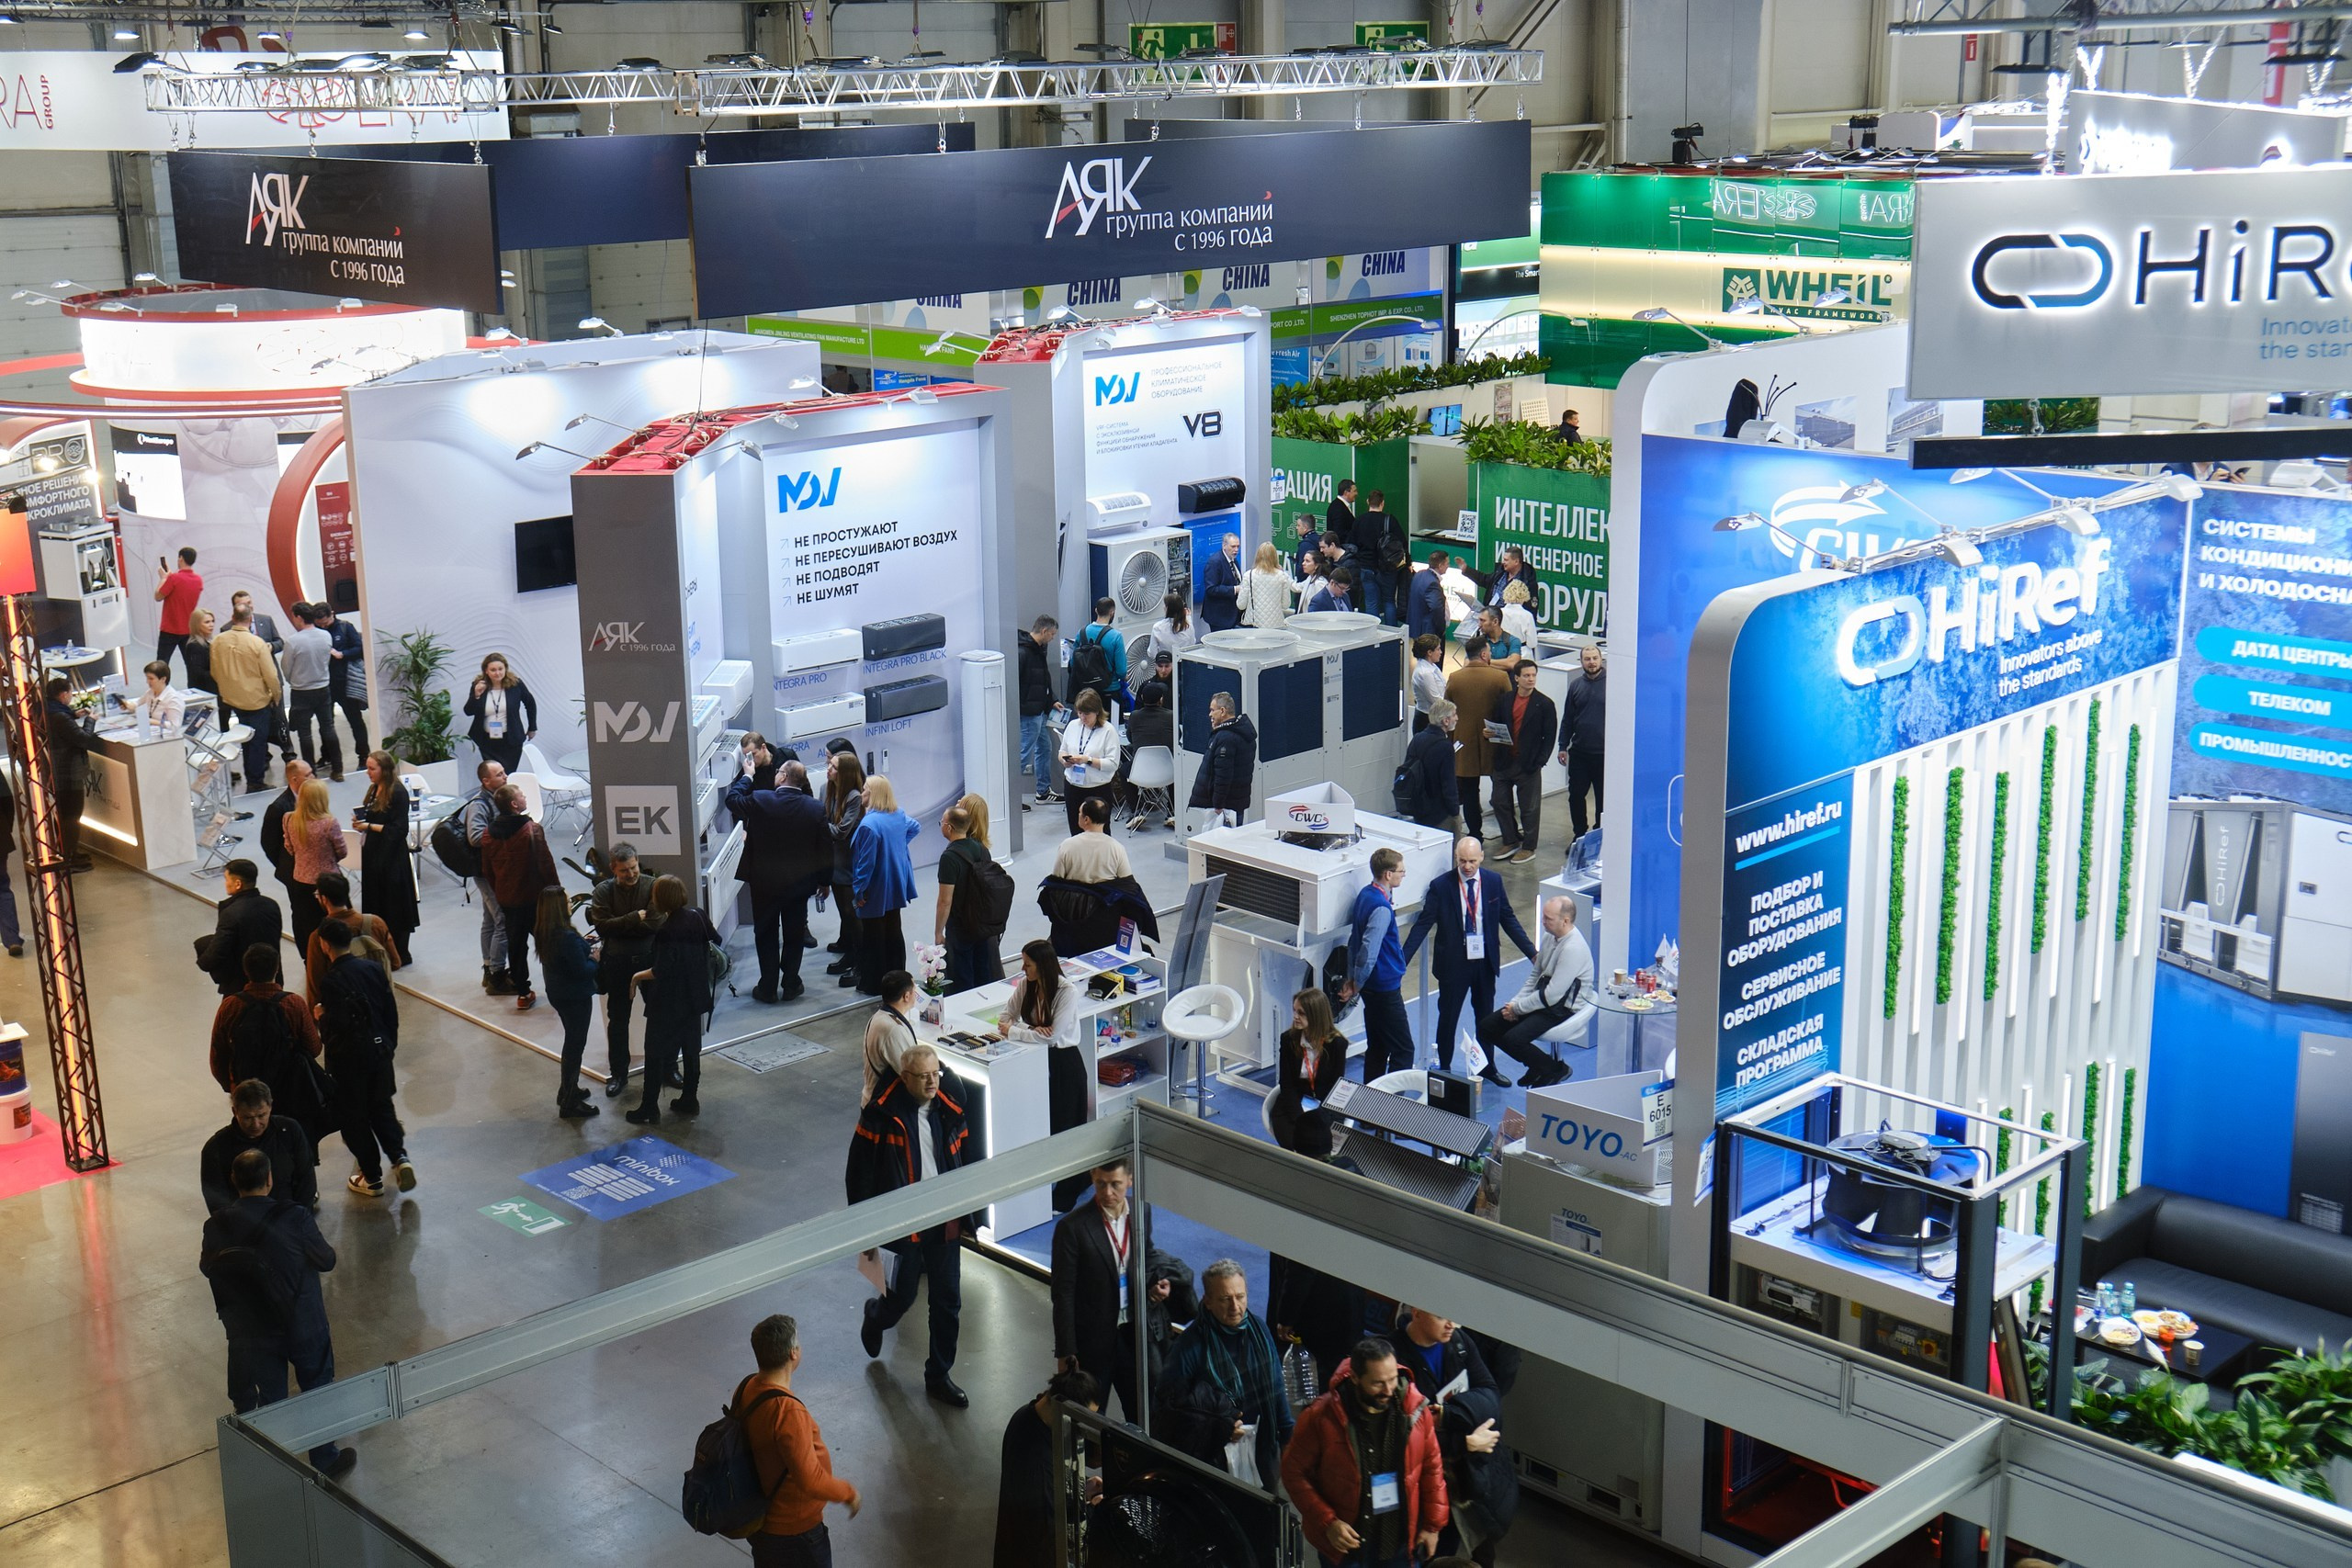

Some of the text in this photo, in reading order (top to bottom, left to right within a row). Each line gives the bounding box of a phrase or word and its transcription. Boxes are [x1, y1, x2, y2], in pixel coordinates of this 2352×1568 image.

[40, 74, 54, 130] GROUP
[1106, 190, 1273, 239] группа компаний
[282, 226, 403, 259] группа компаний
[1191, 230, 1226, 250] 1996
[1230, 225, 1273, 248] года
[342, 261, 368, 281] 1996
[370, 262, 405, 288] года
[1362, 250, 1406, 277] CHINA
[2134, 220, 2352, 306] HiR
[1222, 264, 1271, 292] CHINA
[1067, 277, 1122, 307] CHINA
[1329, 312, 1357, 322] SHENZHEN
[942, 346, 956, 355] FANS
[2260, 341, 2299, 360] the
[1095, 372, 1140, 406] MDV
[1150, 374, 1206, 388] КЛИМАТИЧЕСКОЕ
[1151, 386, 1203, 399] ОБОРУДОВАНИЕ
[1182, 411, 1223, 438] V8
[777, 467, 842, 513] MDV
[794, 521, 899, 548] НЕ ПРОСТУЖАЮТ
[2202, 518, 2316, 545] СИСТЕМЫ
[795, 529, 957, 567] НЕ ПЕРЕСУШИВАЮТ ВОЗДУХ
[796, 560, 880, 586] НЕ ПОДВОДЯТ
[2199, 572, 2215, 589] И
[797, 583, 859, 604] НЕ ШУМЯТ
[1927, 537, 2111, 664] HiRef
[629, 644, 649, 652] 1996
[650, 644, 676, 652] года
[863, 649, 947, 674] INTEGRA PRO BLACK
[1999, 629, 2102, 675] Innovators above
[2231, 640, 2280, 660] ДАТА
[808, 672, 827, 687] PRO
[1998, 656, 2082, 698] the standards
[2247, 691, 2332, 716] ТЕЛЕКОМ
[594, 701, 681, 743] MDV
[865, 719, 912, 738] INFINI LOFT
[2199, 732, 2352, 769] ПРОМЫШЛЕННОС
[1736, 801, 1842, 853] www.hiref.ru
[1751, 870, 1824, 913] ПОДБОР И
[1748, 893, 1824, 937] ПОСТАВКА
[1727, 907, 1842, 967] ОБОРУДОВАНИЯ
[1741, 951, 1826, 1000] СЕРВИСНОЕ
[1723, 966, 1841, 1030] ОБСЛУЖИВАНИЕ
[1736, 1013, 1824, 1066] СКЛАДСКАЯ
[1736, 1035, 1824, 1089] ПРОГРАММА
[1649, 1104, 1672, 1122] 6015
[1657, 1094, 1665, 1107] E
[613, 1154, 681, 1187] minibox
[1562, 1207, 1588, 1224] TOYO
